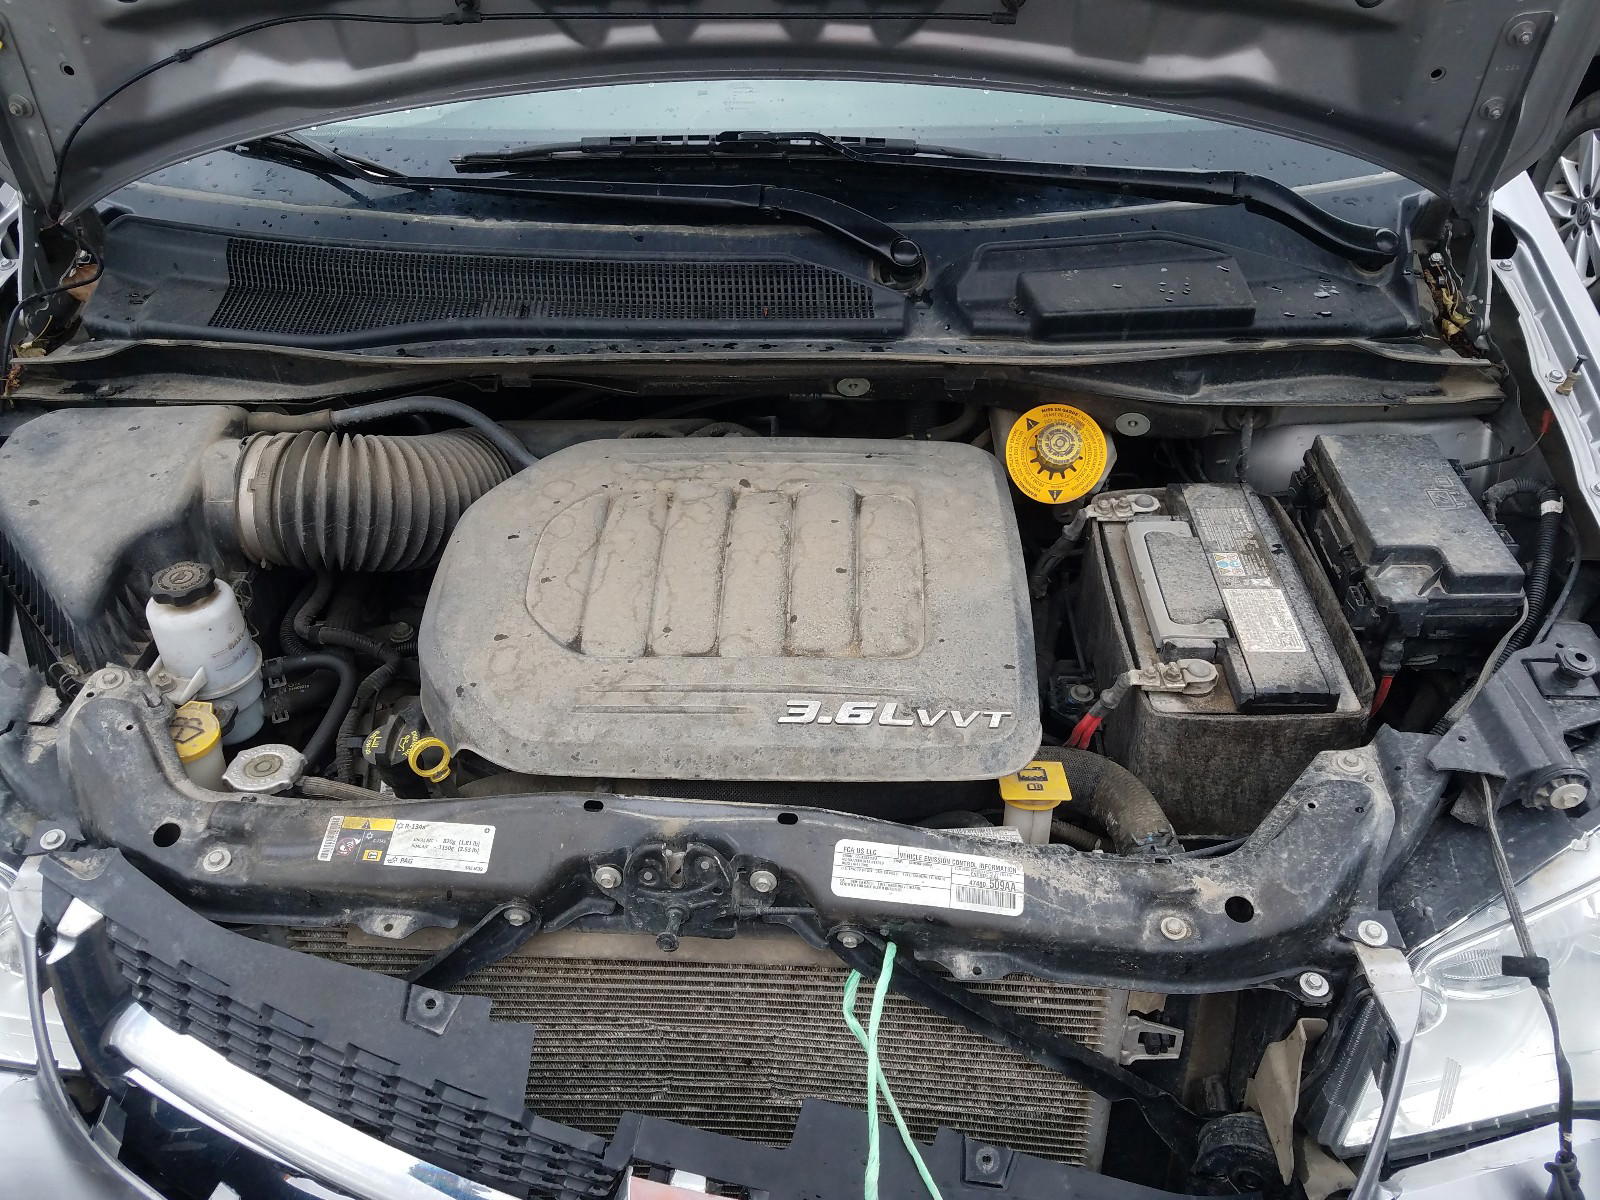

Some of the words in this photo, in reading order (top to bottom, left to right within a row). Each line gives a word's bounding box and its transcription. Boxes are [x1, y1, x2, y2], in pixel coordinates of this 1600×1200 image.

[777, 700, 914, 728] 3.6L
[916, 709, 1013, 728] VVT
[900, 852, 922, 860] VEHICLE
[924, 855, 951, 865] EMISSION
[952, 859, 976, 868] CONTROL
[979, 863, 1017, 874] INFORMATION
[990, 880, 1016, 892] 509AA
